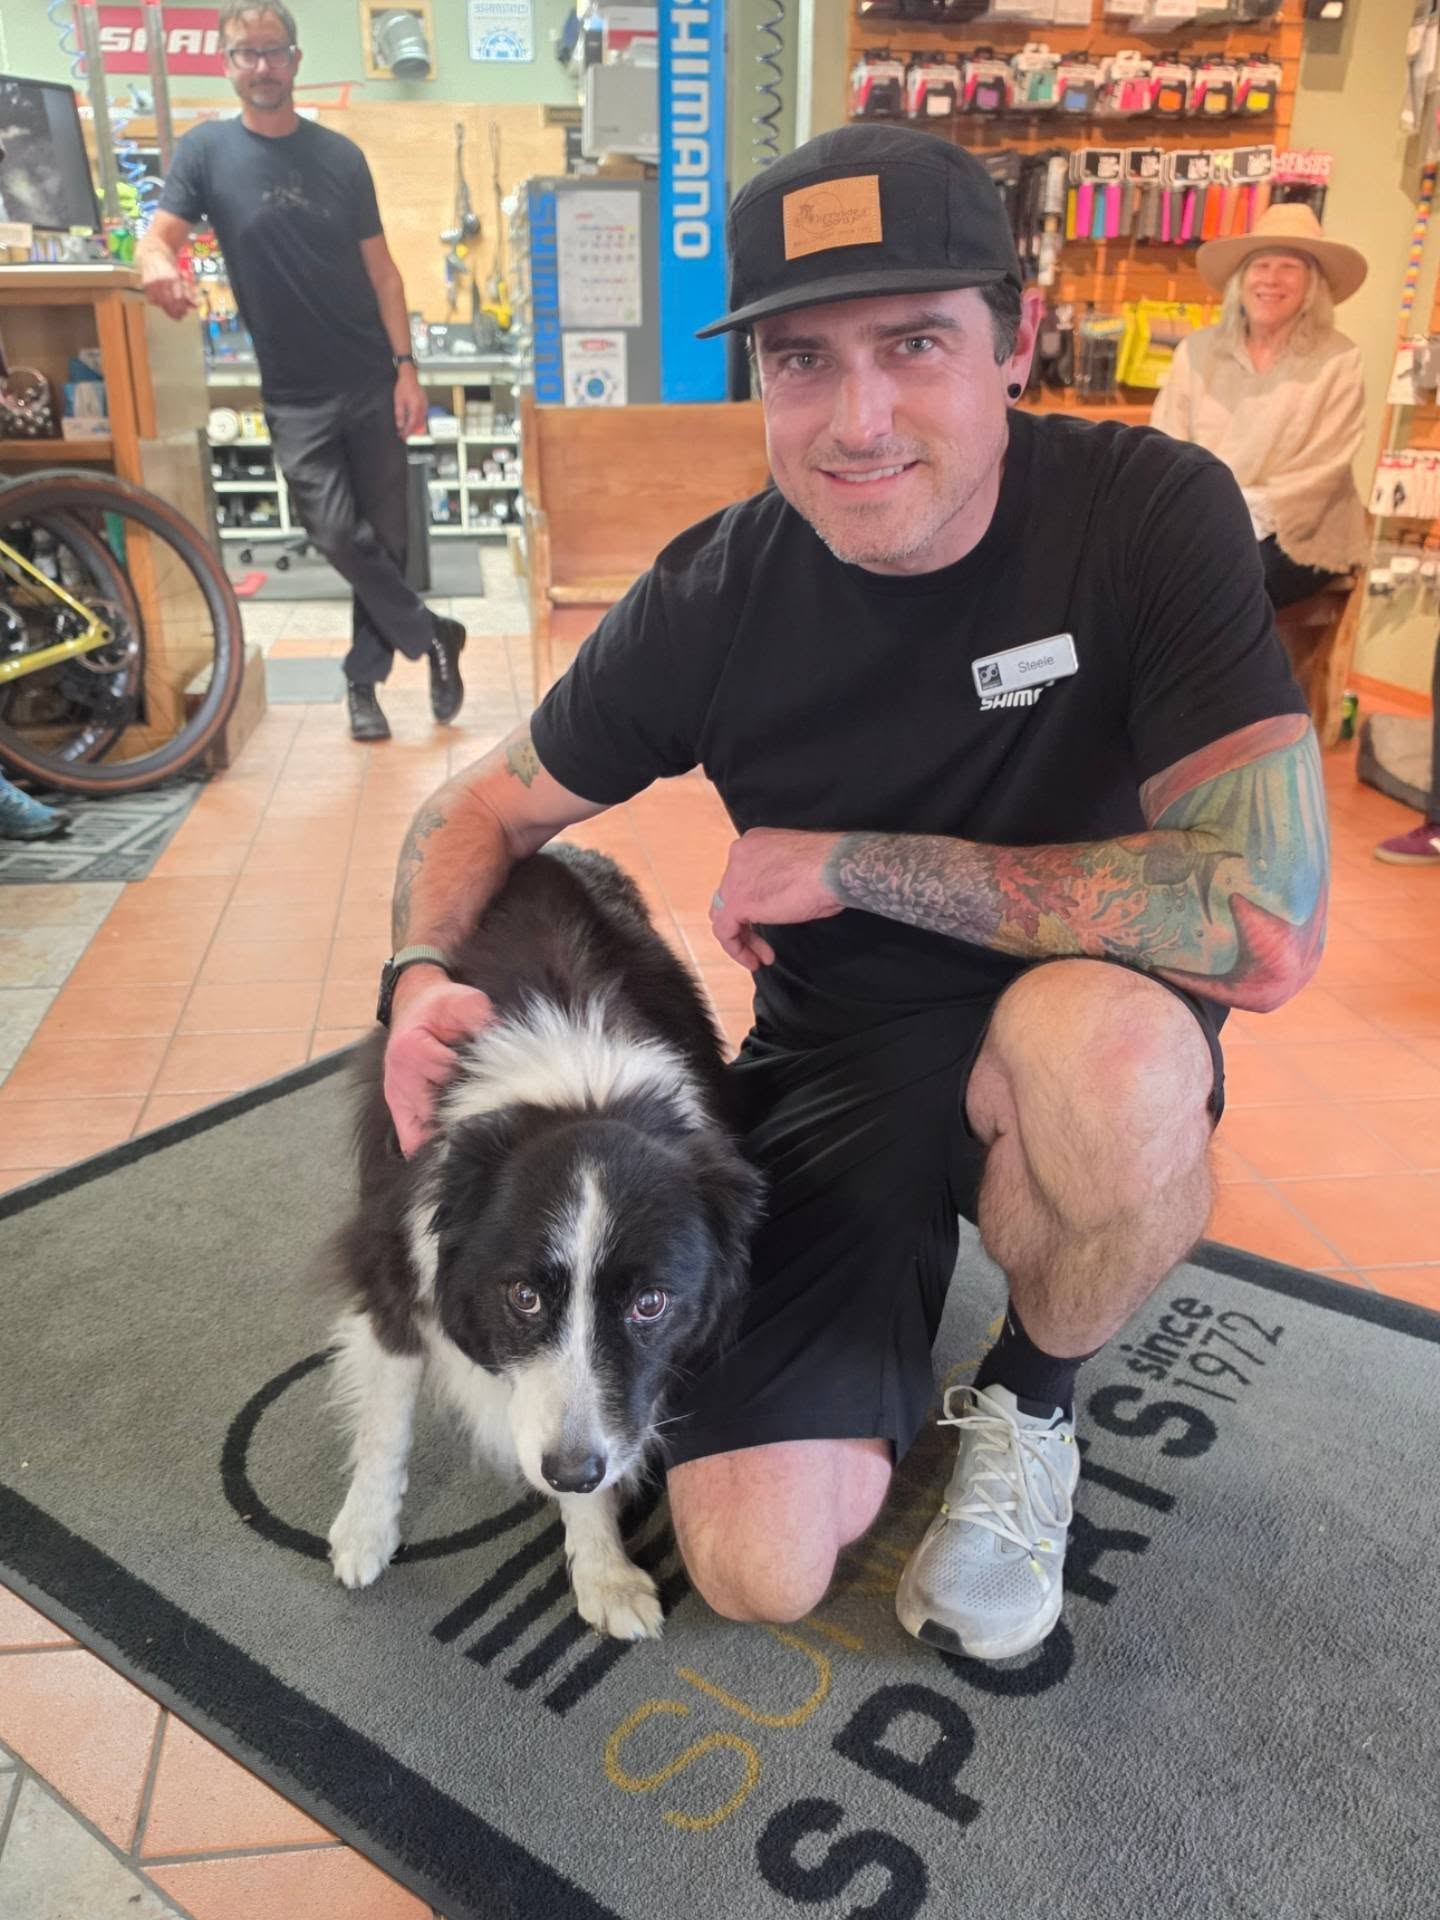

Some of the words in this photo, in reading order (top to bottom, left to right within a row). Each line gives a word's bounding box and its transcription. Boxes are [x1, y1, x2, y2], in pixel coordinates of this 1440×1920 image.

[670, 0, 710, 258] HIMANO
[980, 682, 1055, 711] SHIM
[1018, 656, 1055, 673] Steele
[1120, 1298, 1213, 1381] since
[1173, 1312, 1285, 1403] 1972
